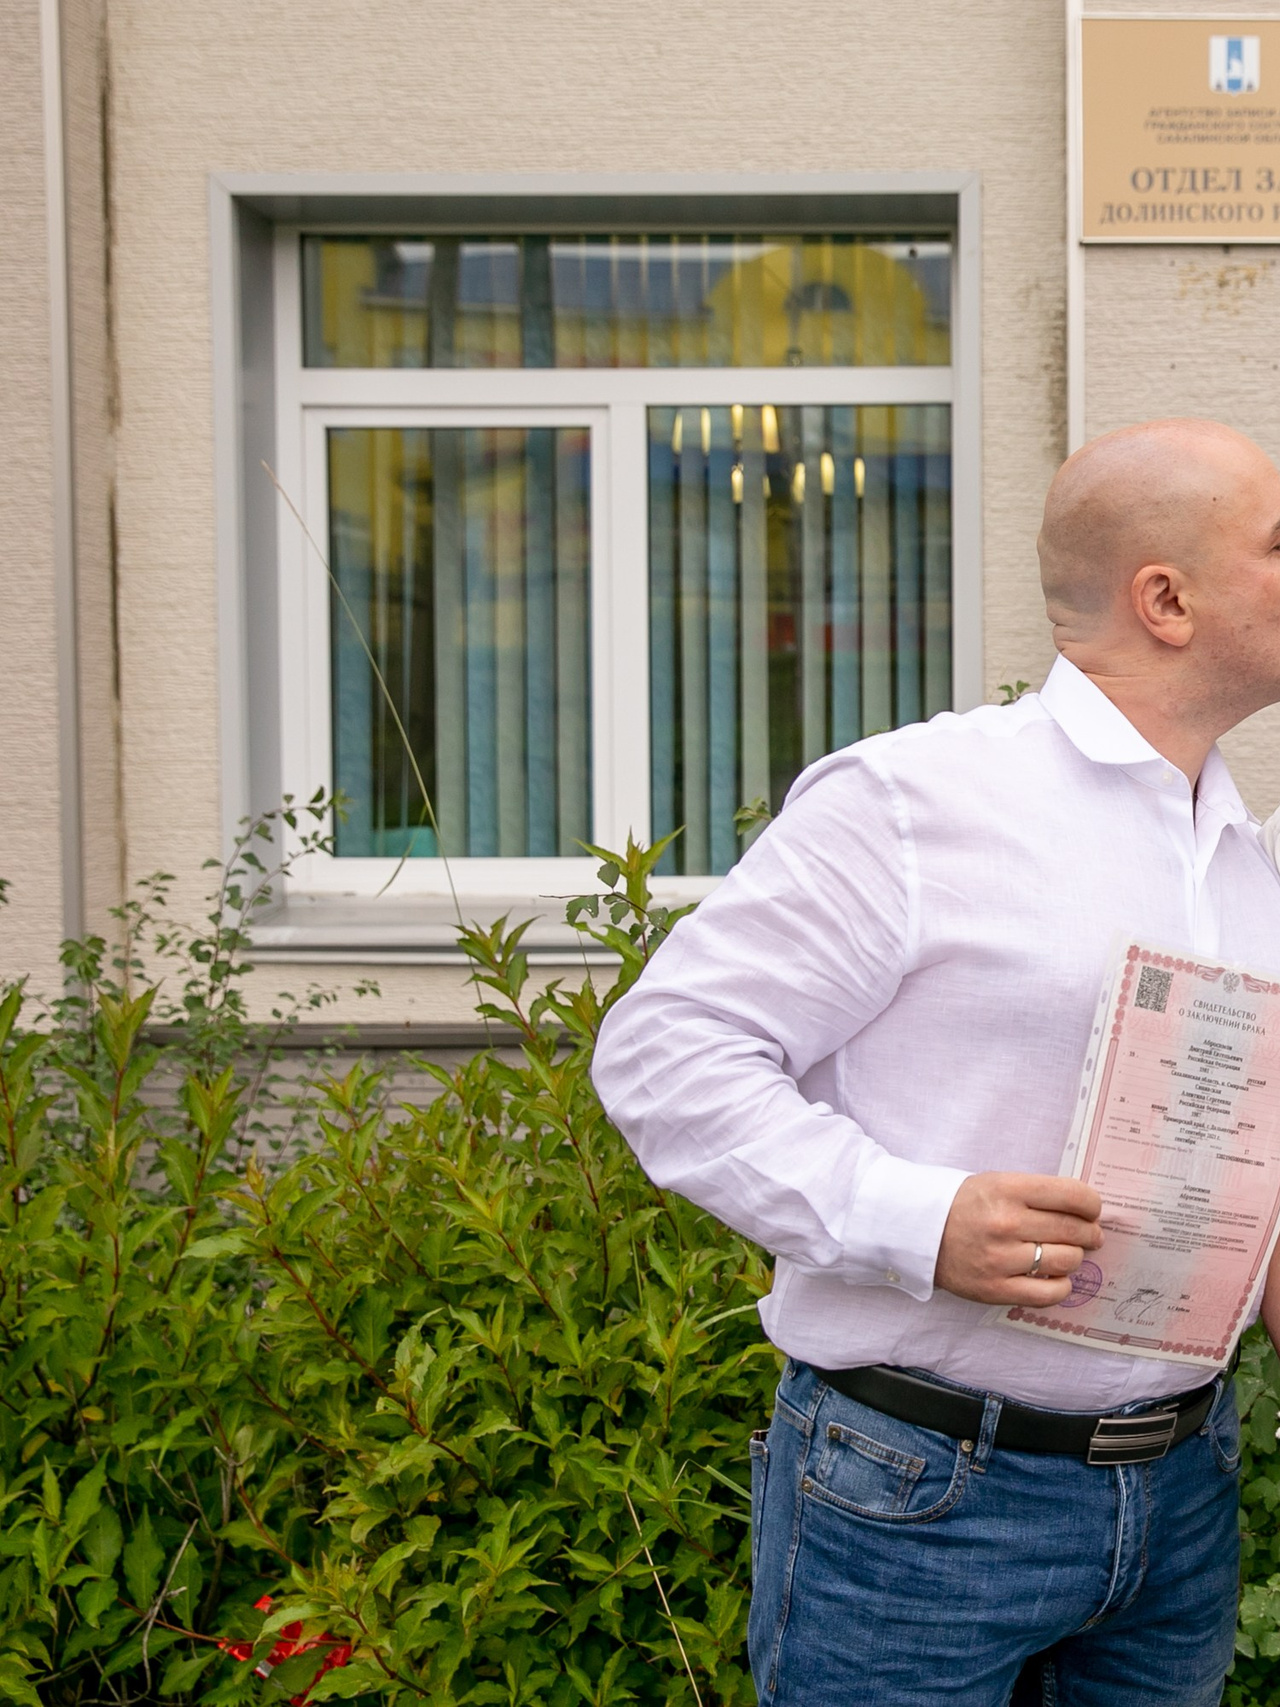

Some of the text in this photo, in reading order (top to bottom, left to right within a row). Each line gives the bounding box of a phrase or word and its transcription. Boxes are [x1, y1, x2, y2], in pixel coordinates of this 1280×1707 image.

[1130, 166, 1241, 195] ОТДЕЛ
[1100, 202, 1264, 226] ДОЛИНСКОГО
[1178, 1008, 1266, 1035] О ЗАКЛЮЧЕНИИ БРАКА
[1193, 1000, 1257, 1021] СВИДЕТЕЛЬСТВО
